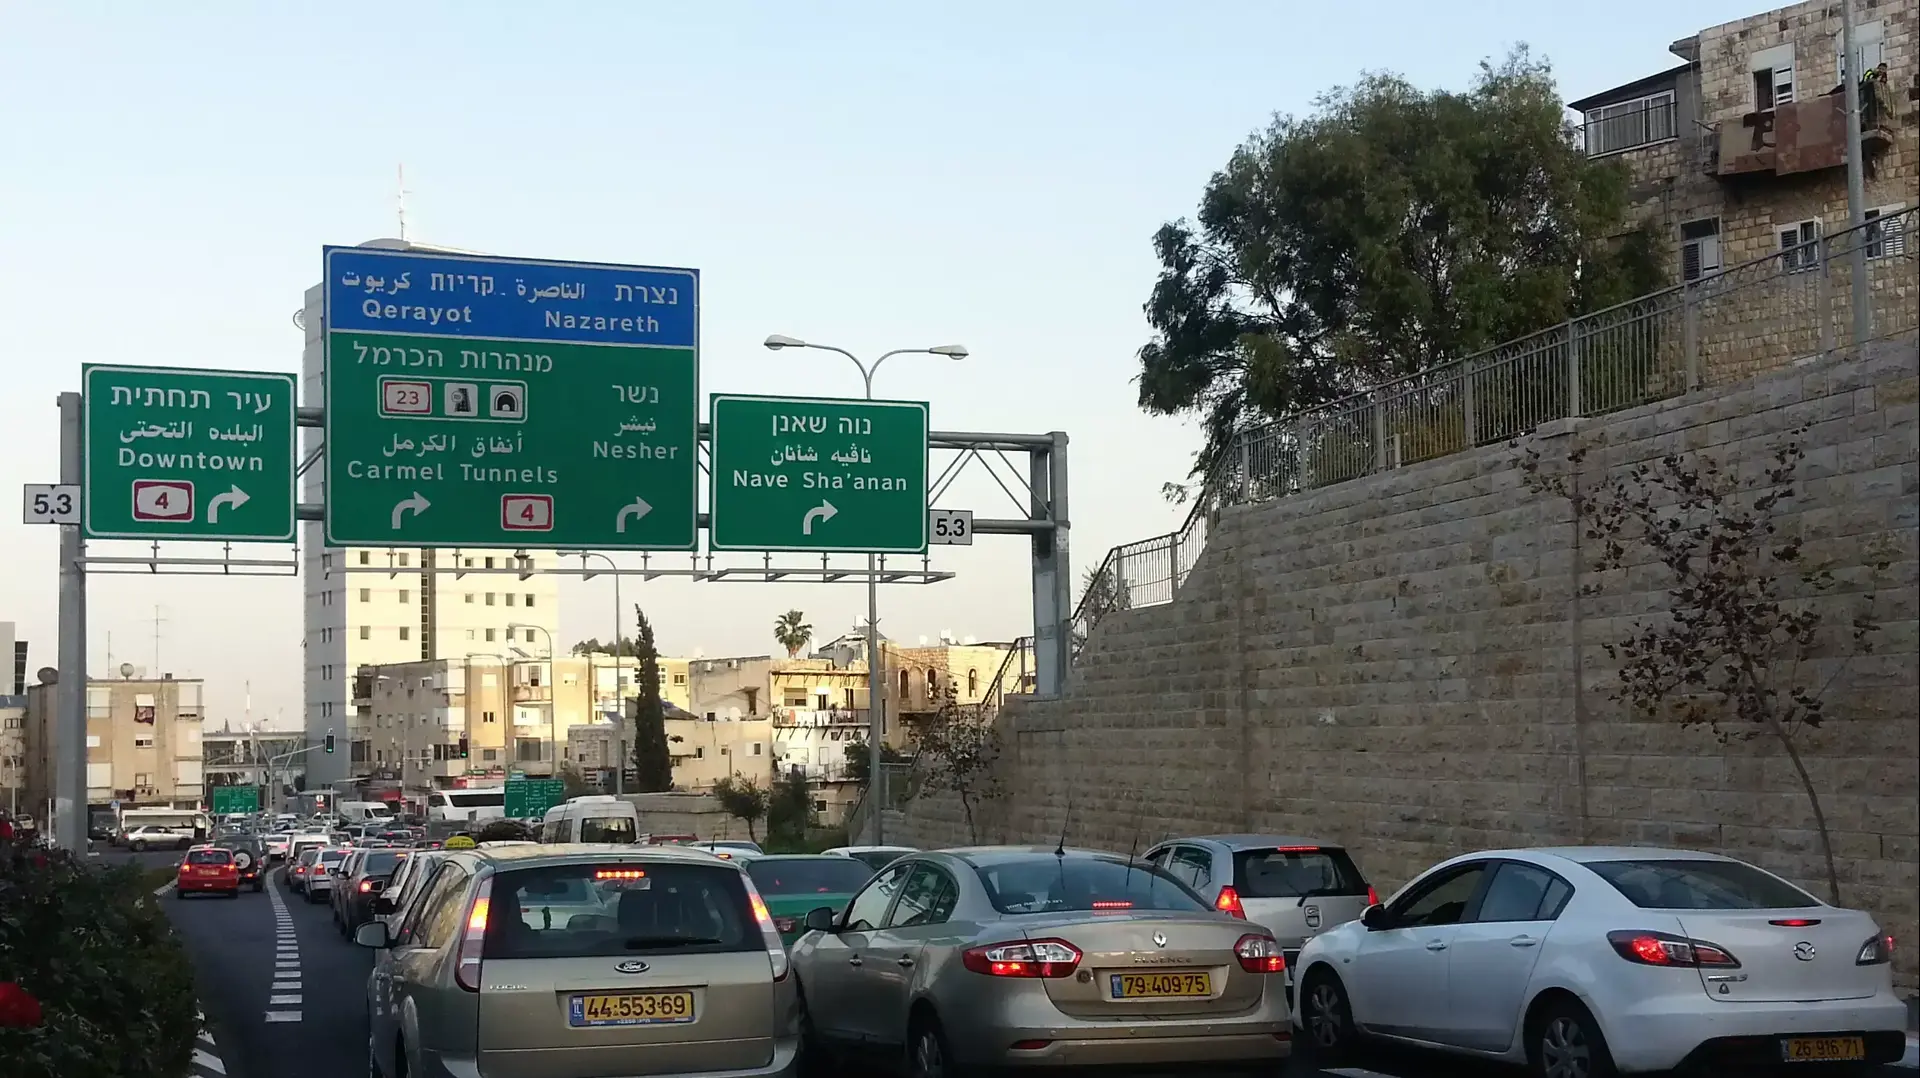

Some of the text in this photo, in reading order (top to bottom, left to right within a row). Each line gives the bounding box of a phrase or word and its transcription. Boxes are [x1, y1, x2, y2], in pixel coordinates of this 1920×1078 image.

[342, 272, 411, 295] كريوت
[430, 272, 494, 296] קריות
[516, 278, 585, 303] الناصرة
[614, 283, 678, 305] נצרת
[362, 299, 472, 325] Qerayot
[545, 310, 659, 333] Nazareth
[353, 341, 553, 373] מנהרות הכרמל
[110, 386, 272, 414] עיר תחתית
[396, 392, 420, 405] 23
[612, 385, 659, 404] נשר
[772, 414, 871, 436] נוה שאנן
[382, 431, 523, 458] أنفاق الكرمل
[593, 440, 678, 460] Nesher
[118, 448, 263, 471] Downtown
[347, 460, 558, 484] Carmel Tunnels
[733, 470, 907, 491] Nave Sha'anan
[33, 494, 73, 515] 5.3
[154, 492, 169, 510] 4
[520, 503, 535, 522] 4
[935, 518, 966, 537] 5.3
